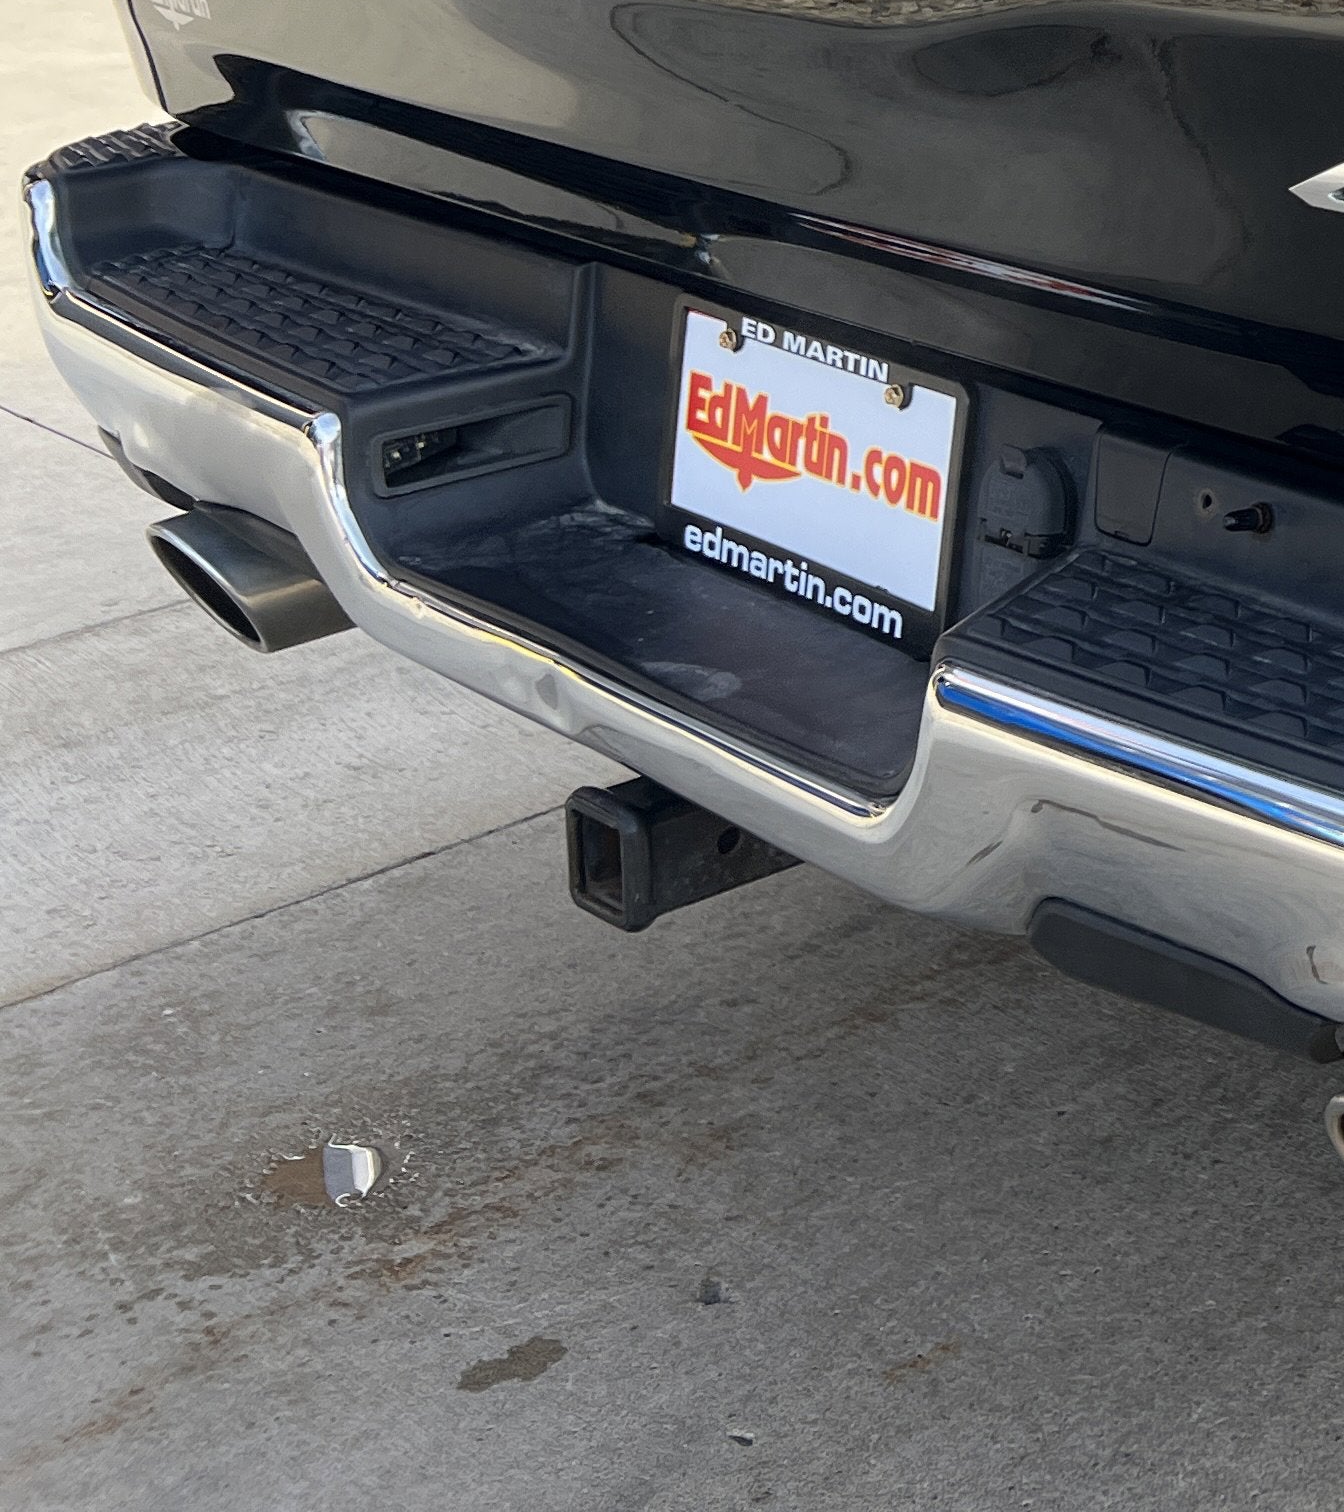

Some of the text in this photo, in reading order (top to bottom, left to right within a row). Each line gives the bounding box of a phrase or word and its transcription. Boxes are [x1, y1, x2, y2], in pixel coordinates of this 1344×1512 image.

[740, 316, 890, 384] ED MARTIN
[685, 368, 943, 523] EdMartin.com
[684, 523, 904, 639] edmartin.com
